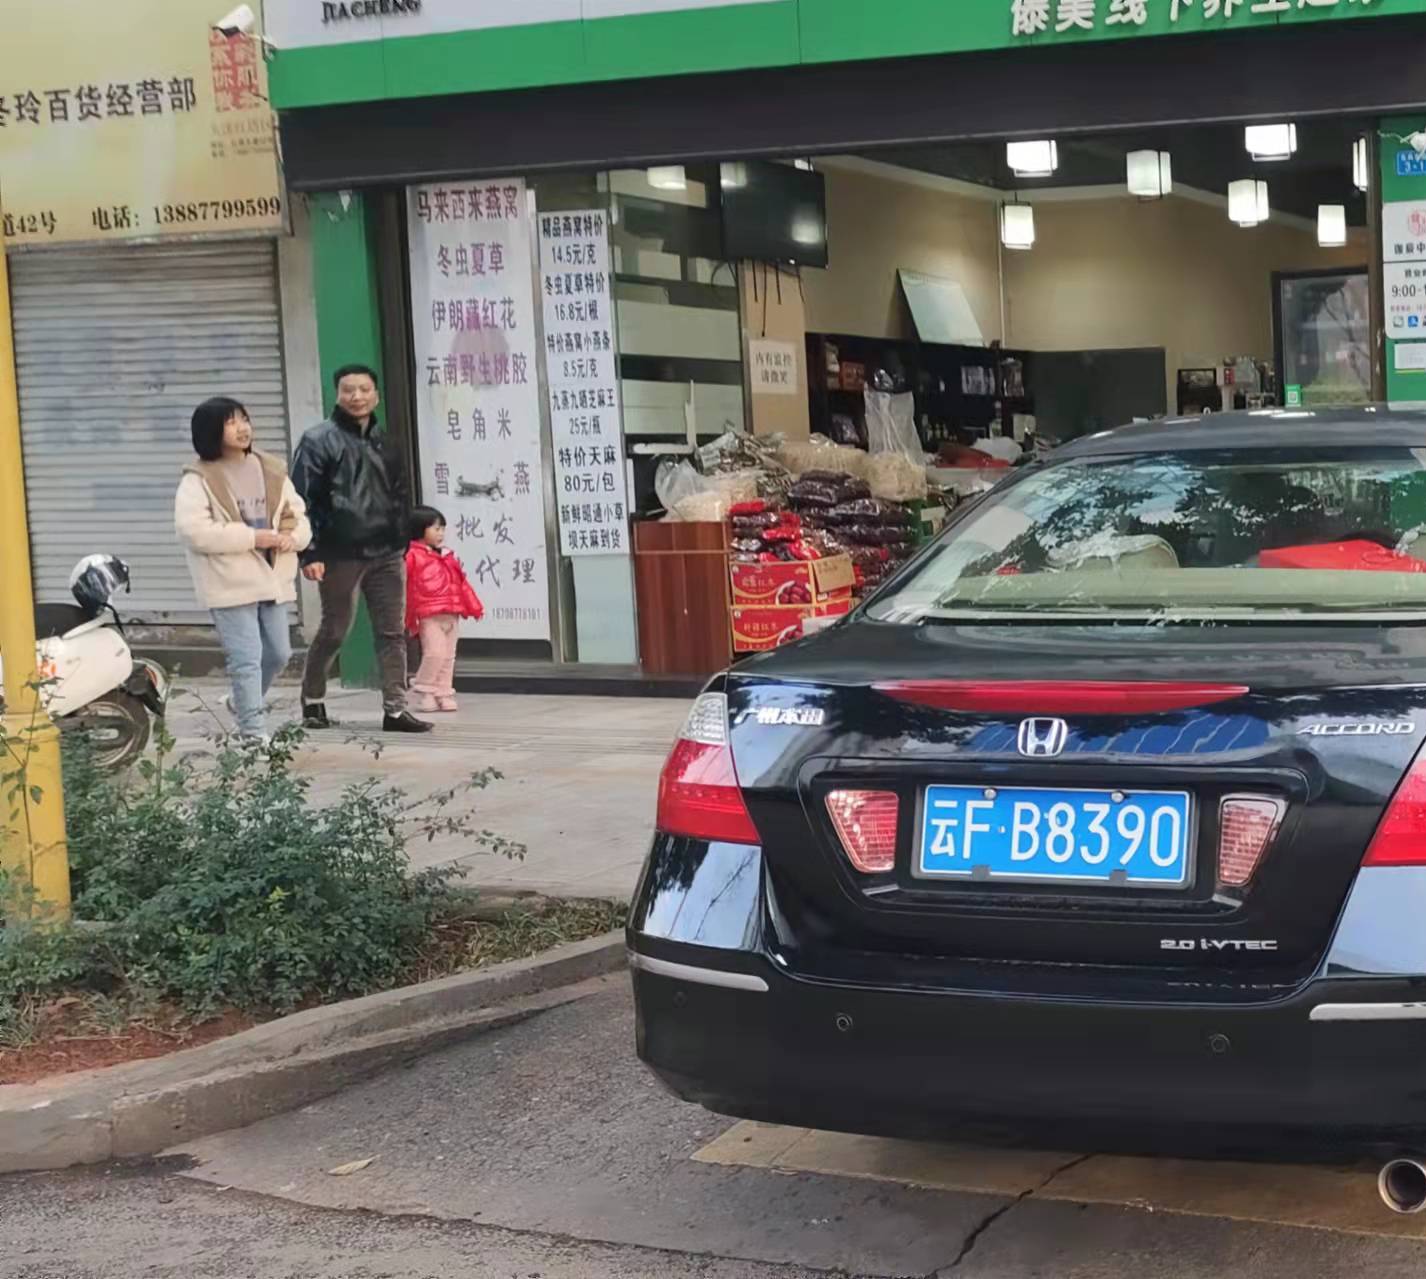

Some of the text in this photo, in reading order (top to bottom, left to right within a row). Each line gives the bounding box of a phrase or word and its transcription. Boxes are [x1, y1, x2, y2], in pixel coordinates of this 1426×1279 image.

[542, 215, 604, 238] 精品燕窝特价
[437, 242, 505, 277] 冬虫夏草
[544, 273, 605, 296] 冬虫夏草特价
[431, 298, 517, 331] 伊朗藏红花
[426, 352, 528, 387] 云南野生桃胶
[447, 408, 512, 441] 皂角米
[558, 444, 617, 468] 特价天麻
[434, 461, 531, 496] 雪 燕
[564, 471, 616, 493] 80元/包
[455, 513, 516, 545] 批发
[568, 528, 622, 550] 坝天麻到货
[459, 554, 536, 589] 代理
[1296, 721, 1416, 736] ACCORD
[1200, 938, 1279, 951] i-VTEC
